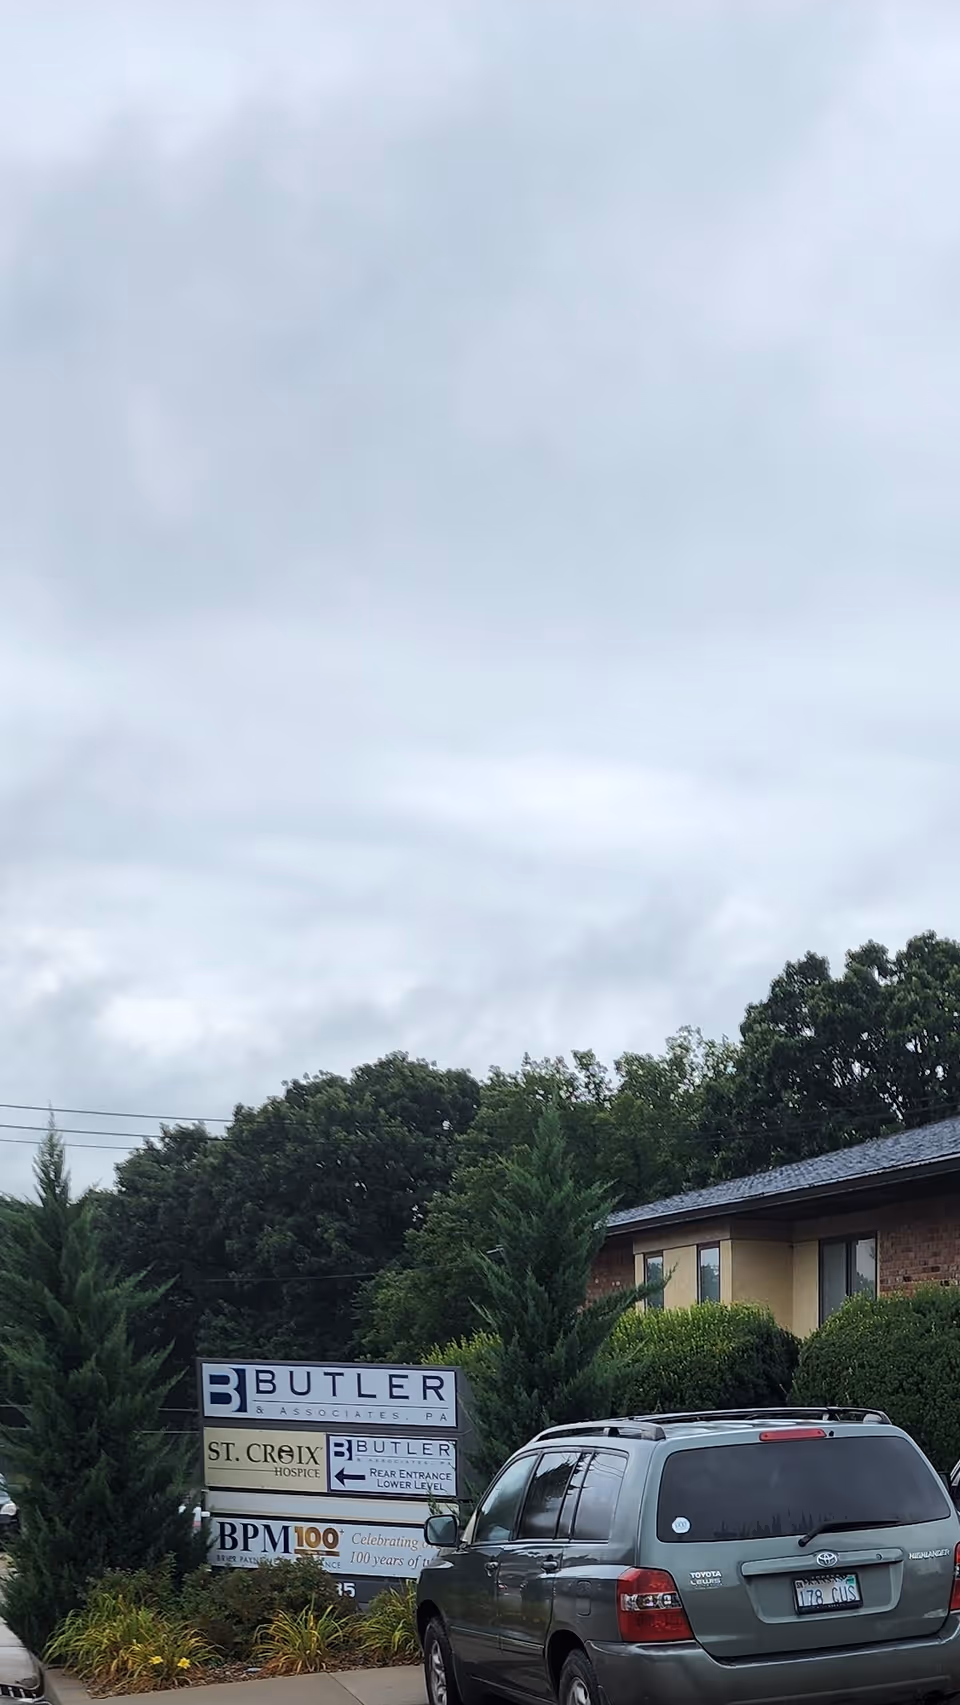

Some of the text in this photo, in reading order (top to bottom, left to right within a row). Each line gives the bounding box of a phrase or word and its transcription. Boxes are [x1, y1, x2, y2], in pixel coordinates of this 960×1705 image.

[255, 1368, 446, 1402] BUTLER
[208, 1441, 320, 1466] ST. CROIX
[356, 1440, 450, 1457] BUTLER
[274, 1467, 321, 1478] HOSPICE
[370, 1468, 453, 1481] REAR ENTRANCE
[377, 1479, 445, 1491] LOWER LEVEL
[217, 1521, 293, 1555] BPM
[351, 1532, 419, 1552] Celebrating
[350, 1551, 371, 1564] 100
[372, 1555, 405, 1568] years
[407, 1554, 422, 1571] of
[690, 1570, 722, 1579] TOYOTA
